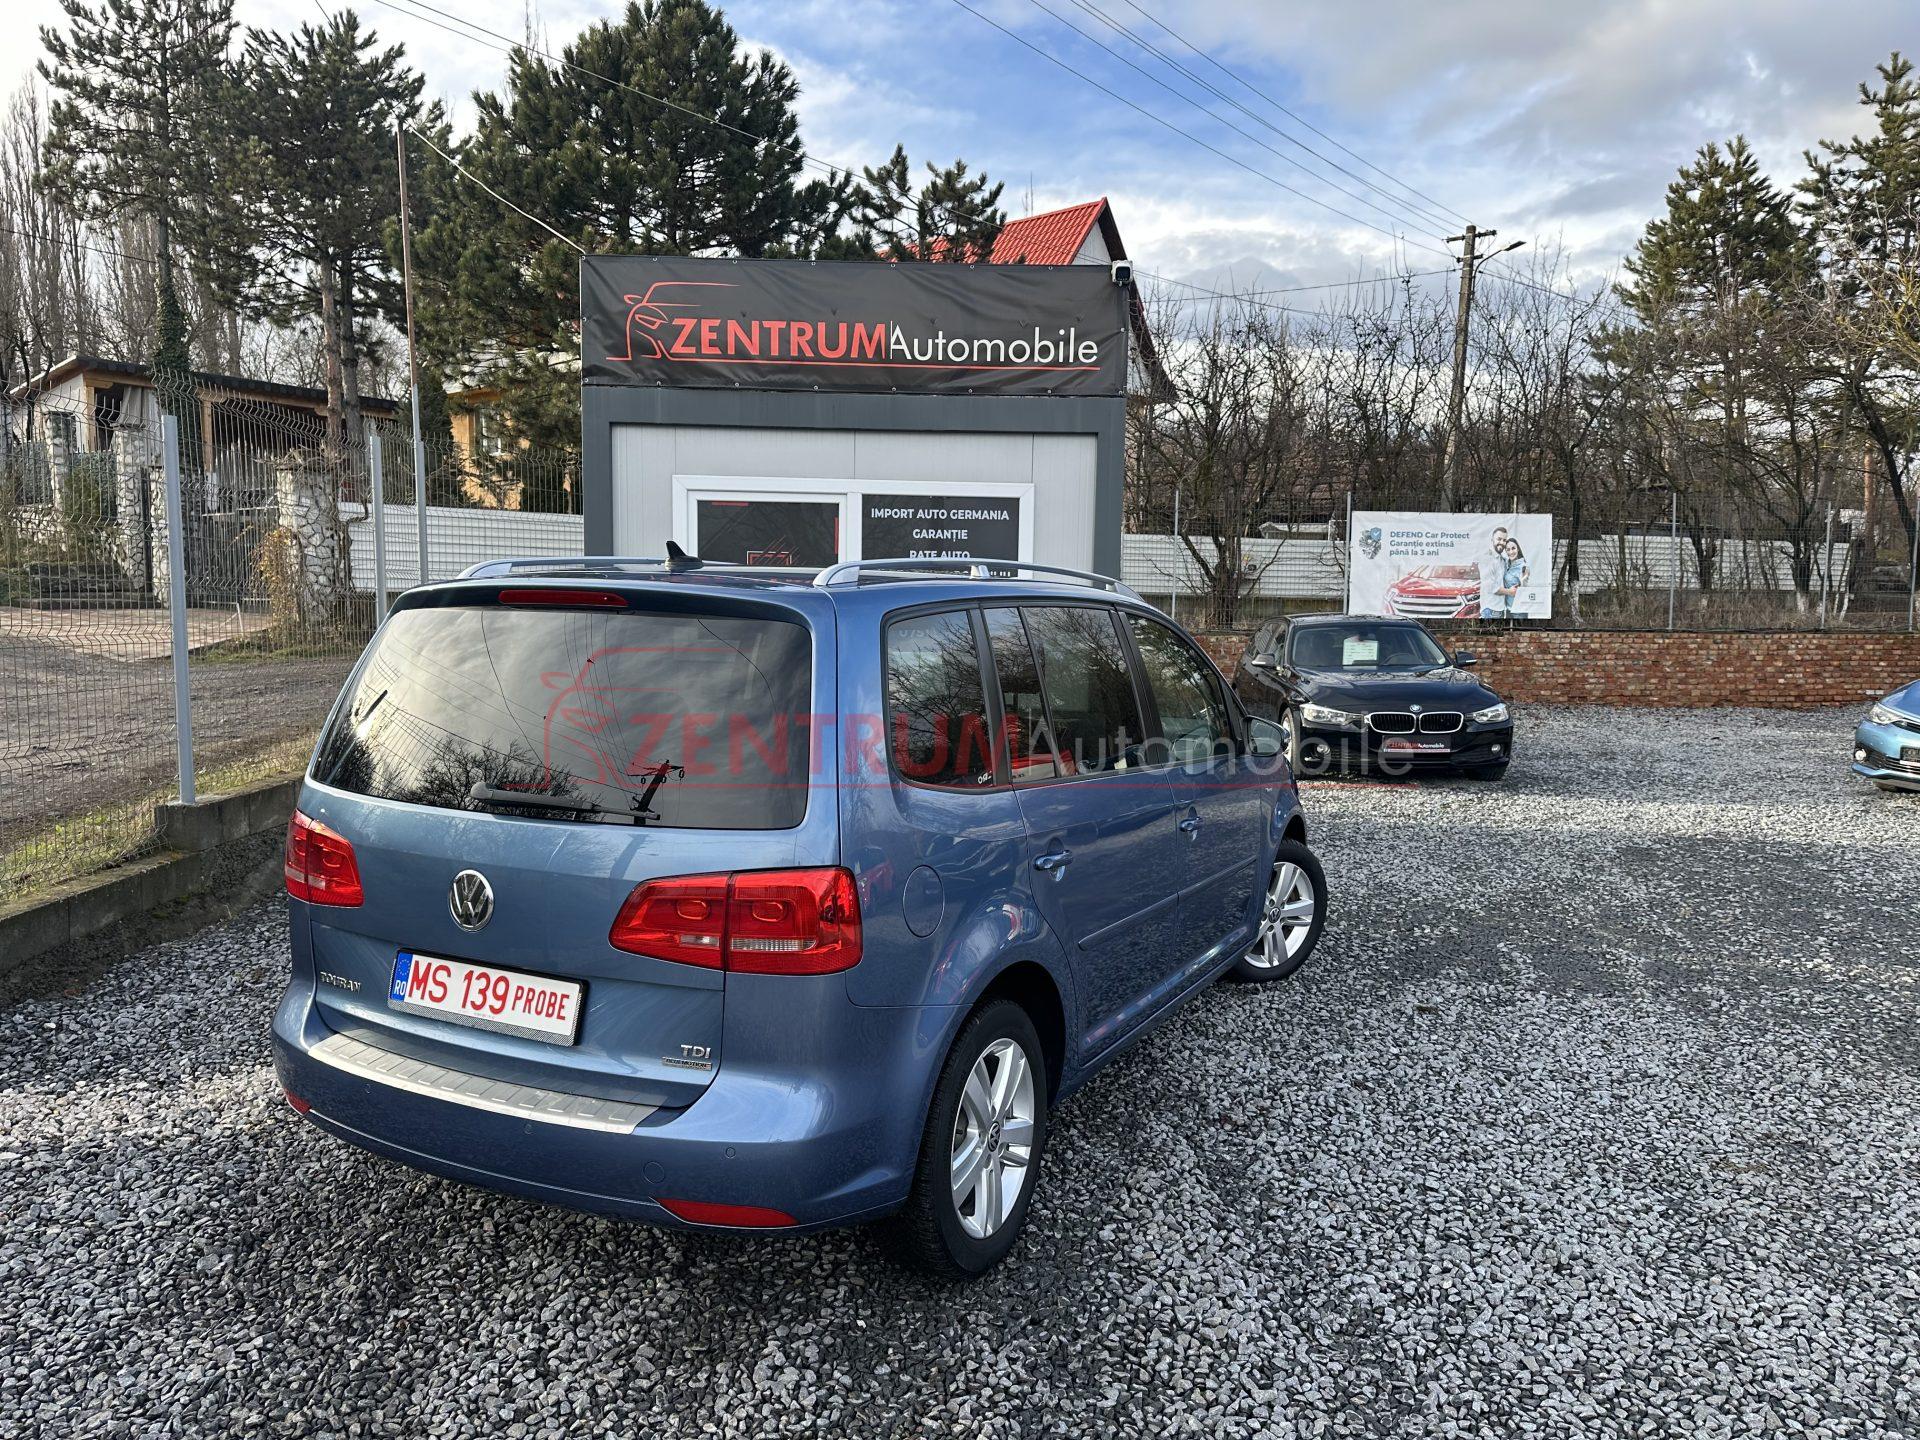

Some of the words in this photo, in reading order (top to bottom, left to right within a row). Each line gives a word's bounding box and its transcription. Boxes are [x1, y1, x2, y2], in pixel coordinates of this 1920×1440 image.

[671, 318, 886, 359] ZENTRUM
[890, 321, 1099, 364] Automobile
[871, 508, 914, 519] IMPORT
[917, 509, 947, 520] AUTO
[950, 510, 1009, 521] GERMANIA
[1390, 530, 1423, 539] DEFEND
[1425, 531, 1438, 540] Car
[1440, 531, 1469, 540] Protect
[909, 550, 937, 559] RATE
[940, 550, 970, 559] AUTO
[1427, 548, 1439, 556] ani
[393, 980, 407, 996] RO
[408, 960, 452, 1004] MS
[461, 970, 511, 1015] 139
[511, 985, 570, 1021] PROBE
[680, 1044, 711, 1059] TDI
